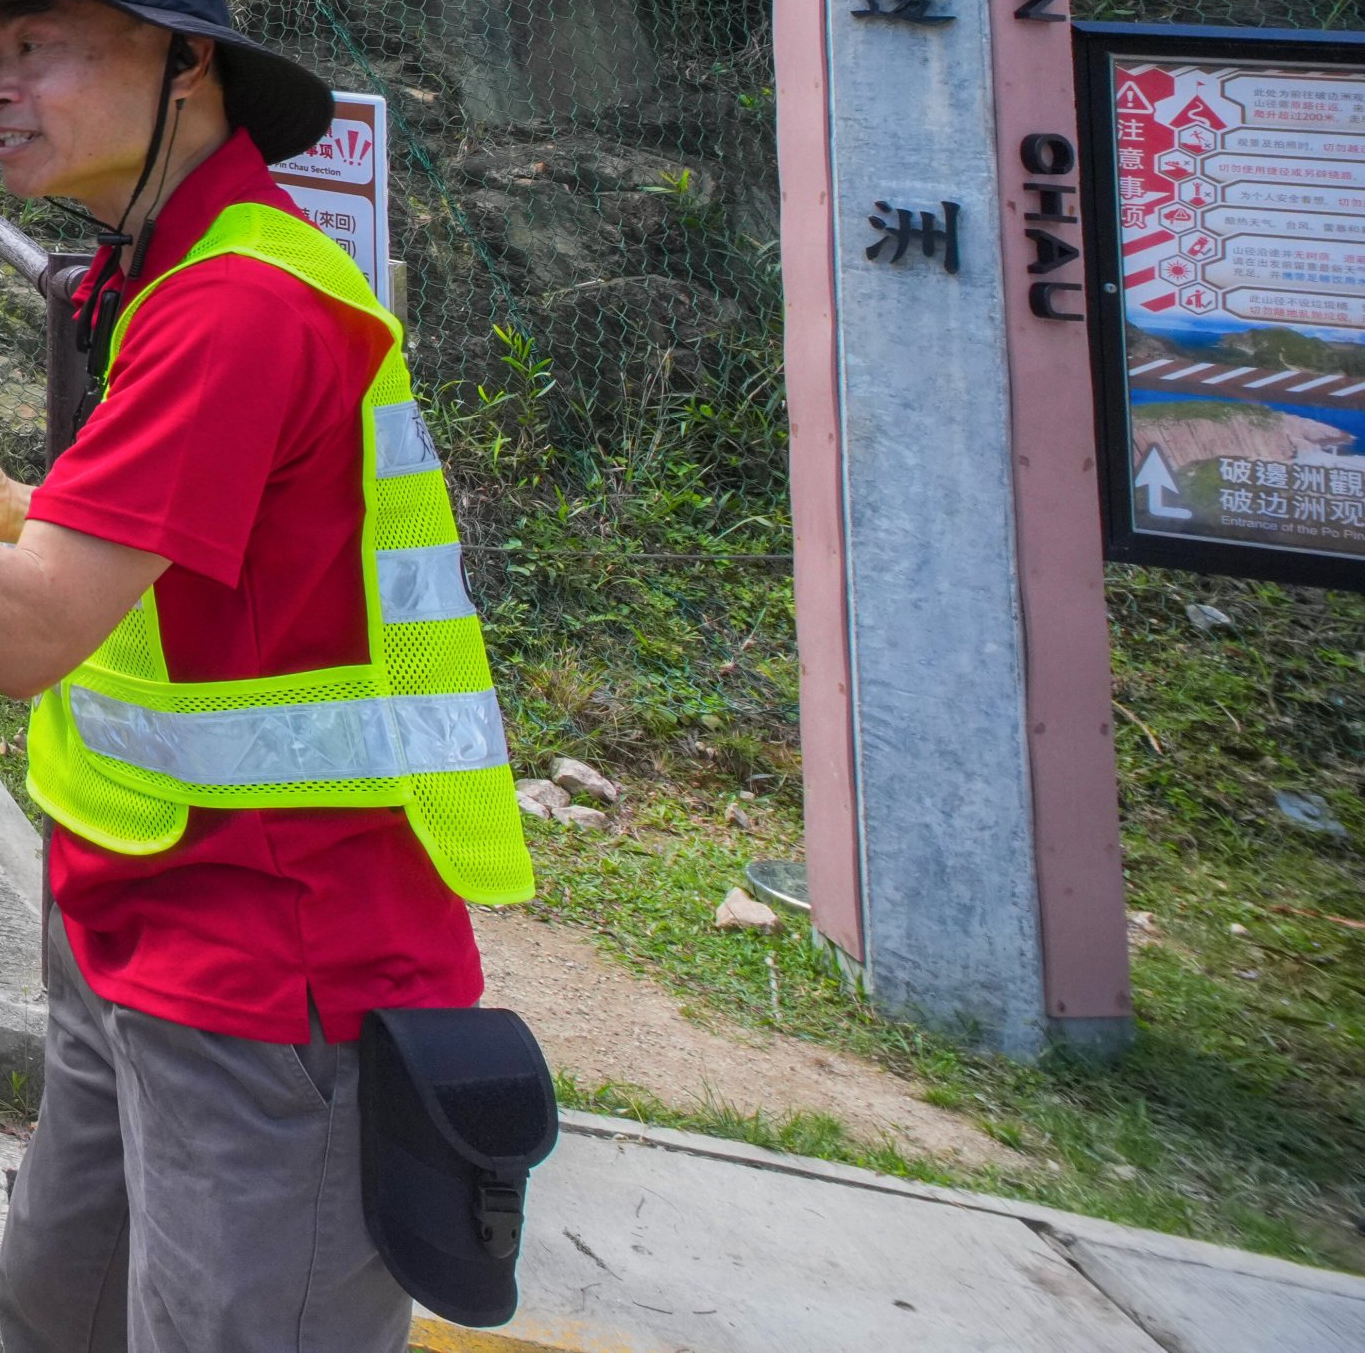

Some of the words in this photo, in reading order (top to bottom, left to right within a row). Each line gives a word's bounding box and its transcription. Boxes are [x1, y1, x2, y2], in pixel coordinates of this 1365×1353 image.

[289, 162, 309, 172] Chau
[311, 165, 341, 176] Section
[1117, 118, 1147, 229] 注意事项
[1020, 132, 1085, 323] CHAU
[1221, 515, 1278, 531] Entrance
[1281, 523, 1294, 532] of
[1297, 524, 1318, 535] the
[1321, 526, 1340, 538] Po
